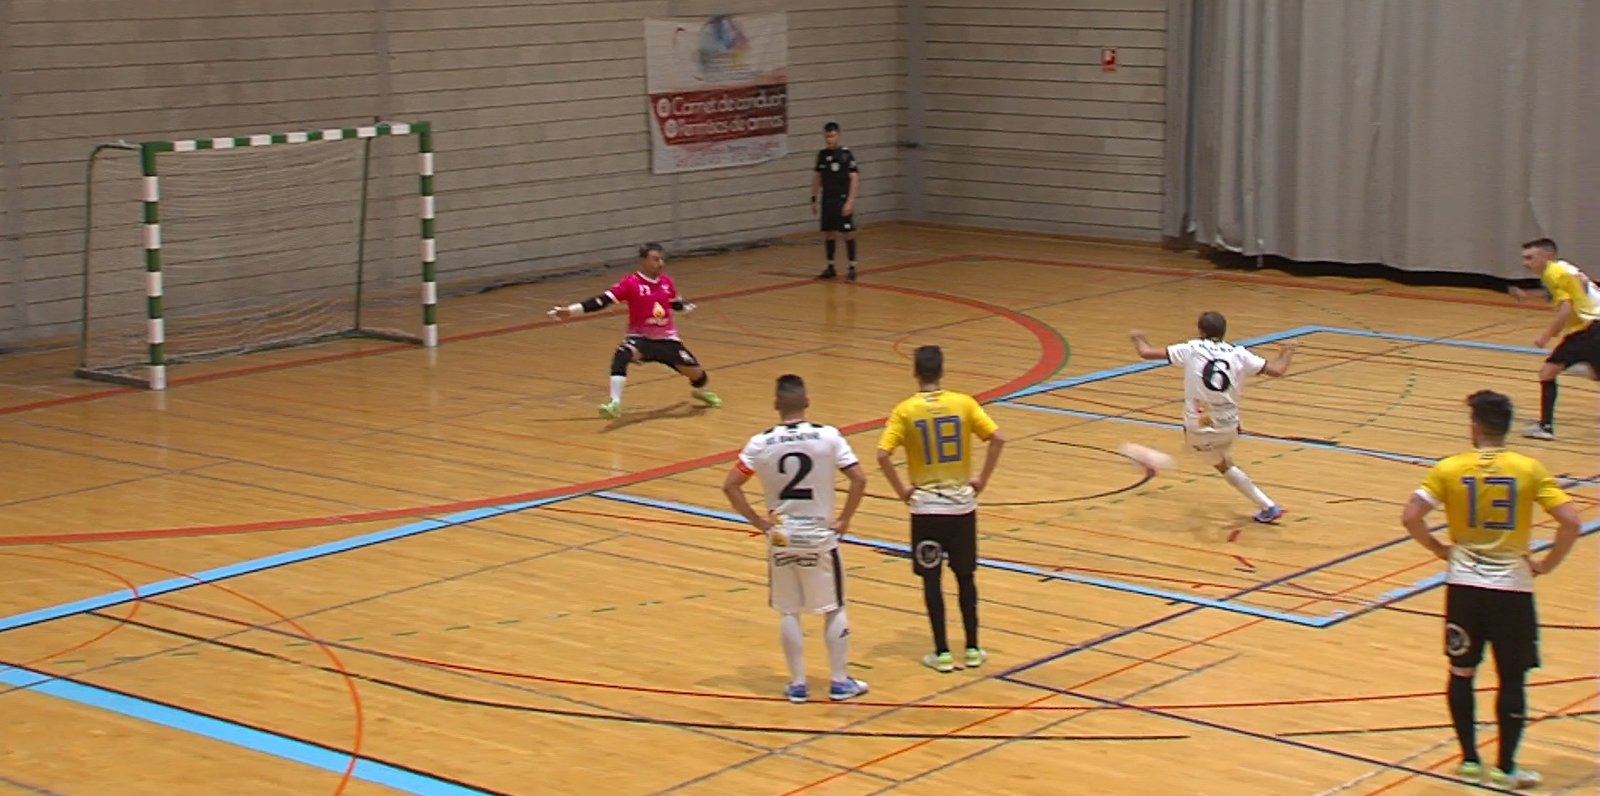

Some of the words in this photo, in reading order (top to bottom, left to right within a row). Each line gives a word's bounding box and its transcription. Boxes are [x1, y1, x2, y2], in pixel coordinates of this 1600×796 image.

[672, 96, 717, 115] Carnet
[718, 94, 736, 112] de
[729, 115, 745, 132] de
[746, 115, 784, 130] armas
[1202, 359, 1231, 392] 6
[914, 415, 962, 464] 18
[778, 452, 813, 500] 2
[1461, 476, 1516, 530] 13
